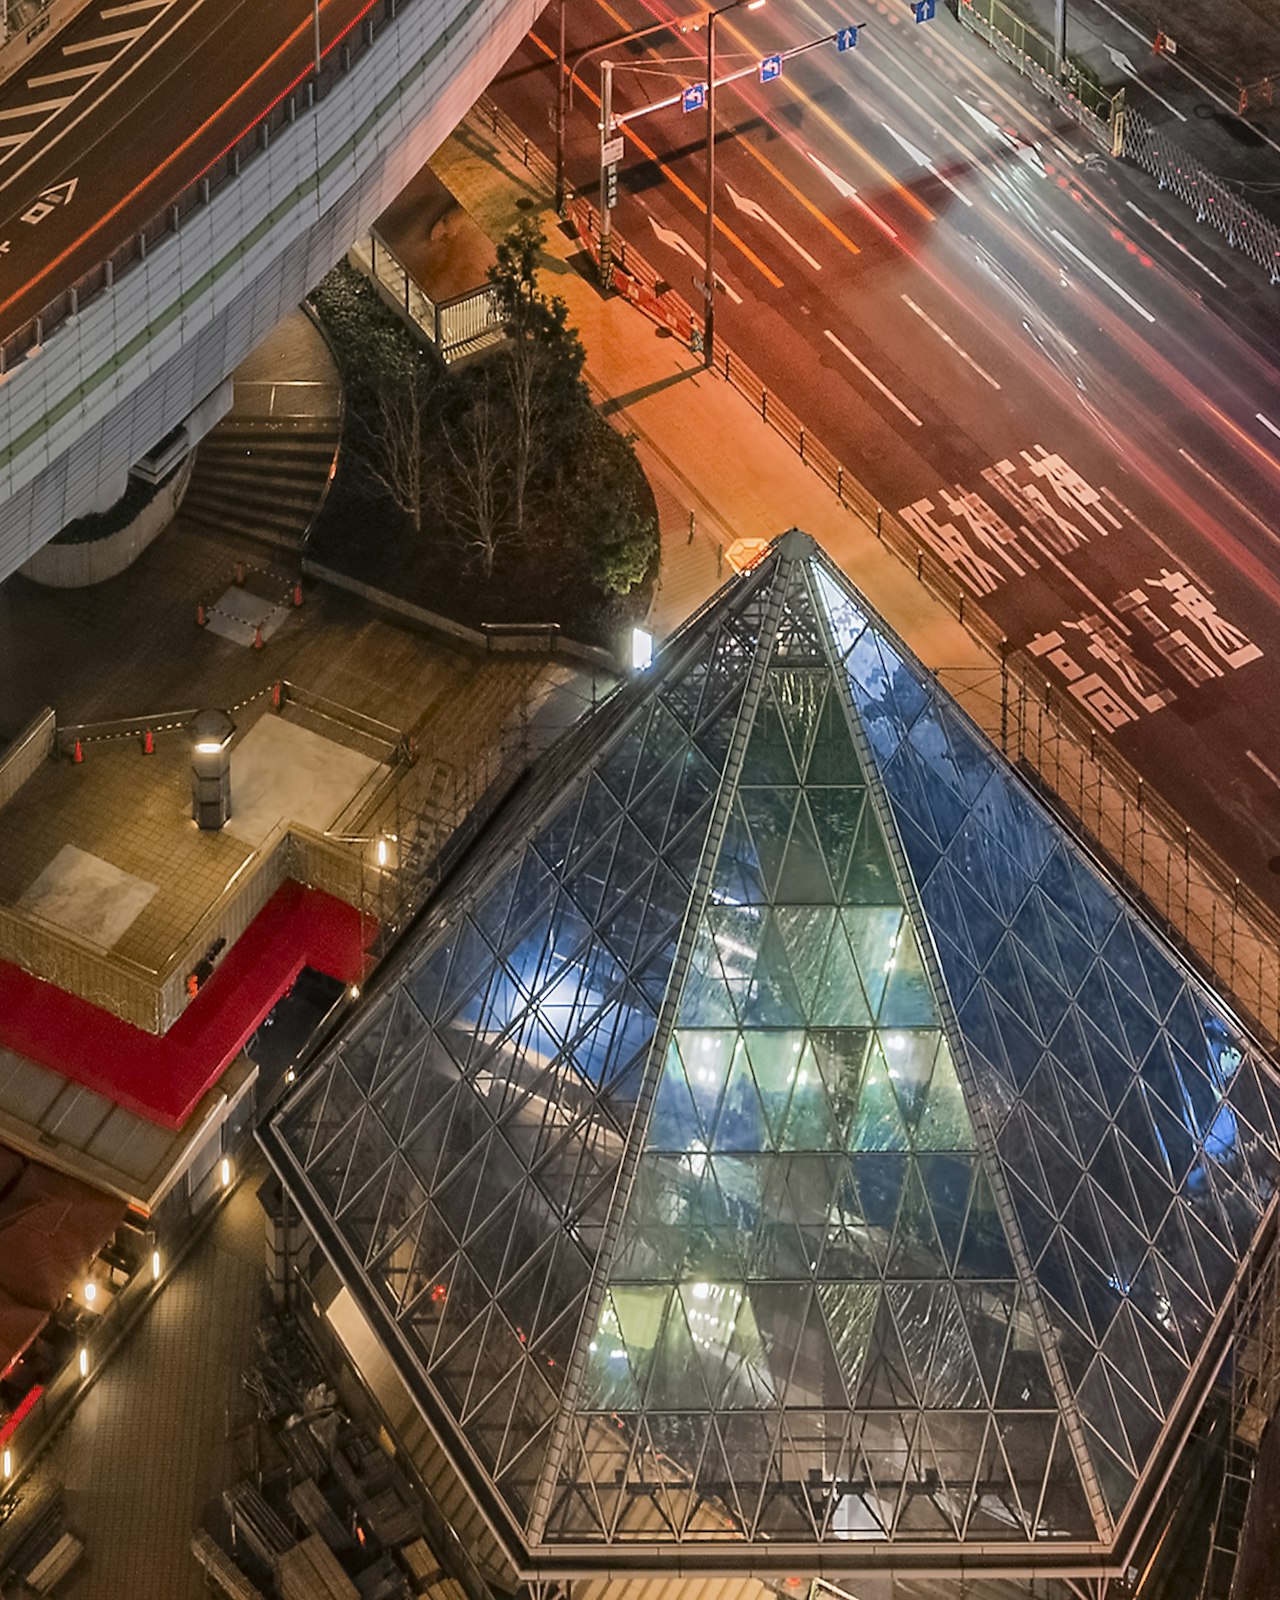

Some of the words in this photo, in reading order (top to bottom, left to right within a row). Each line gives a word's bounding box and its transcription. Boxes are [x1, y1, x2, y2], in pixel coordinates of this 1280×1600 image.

[898, 483, 1041, 598] 阪神
[982, 443, 1124, 555] 阪神
[1025, 611, 1177, 733] 高速
[1114, 567, 1265, 686] 高速
